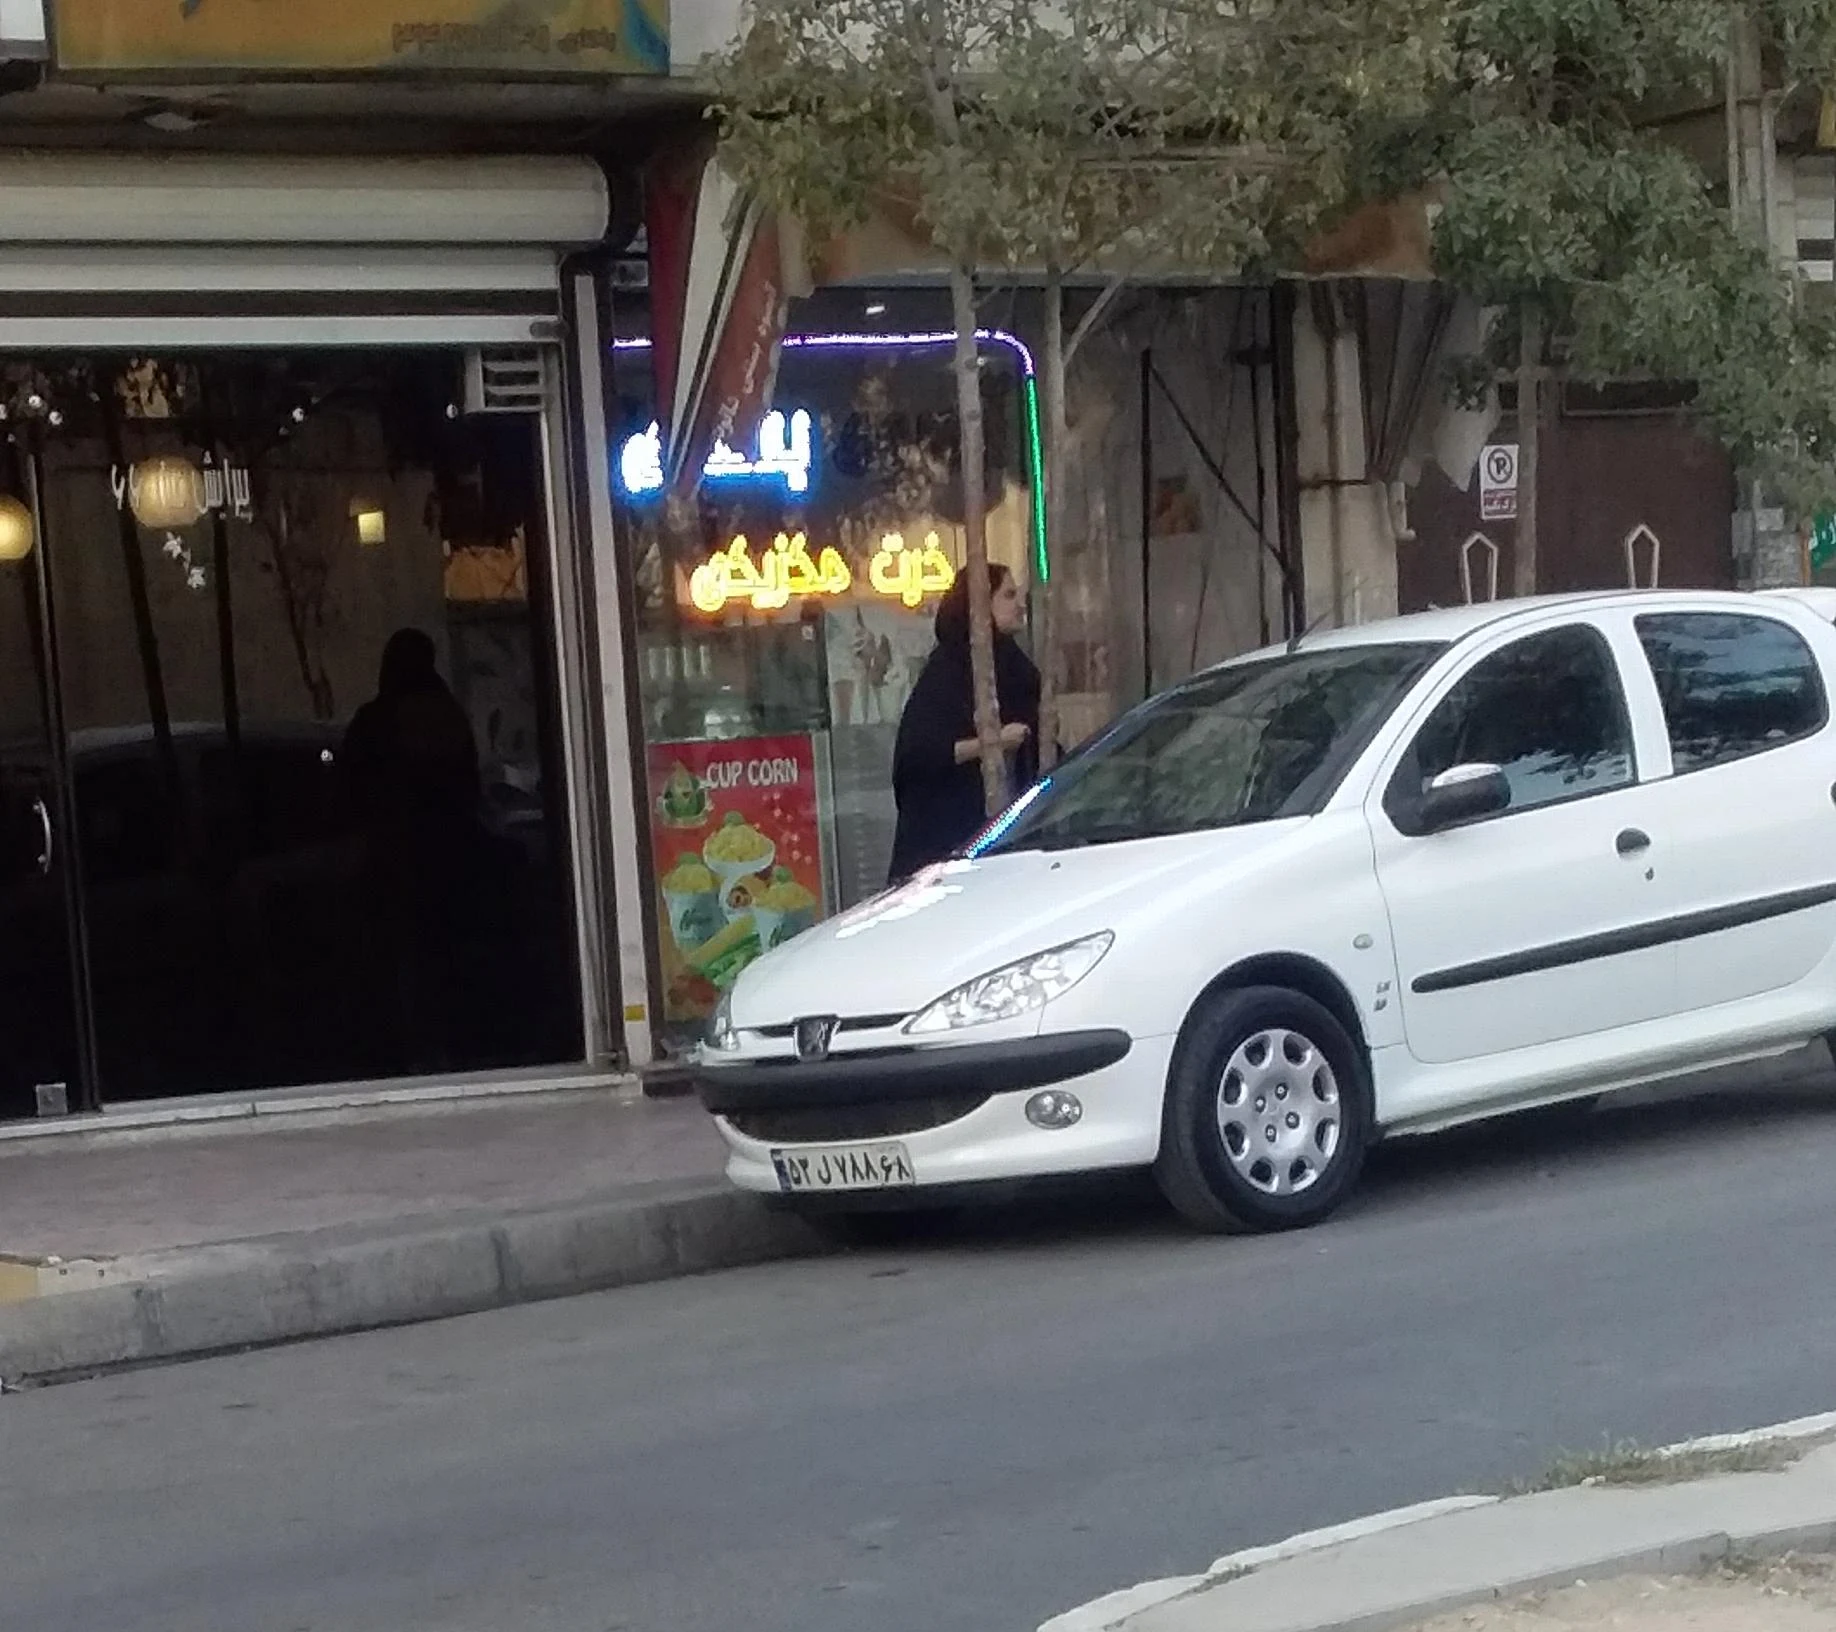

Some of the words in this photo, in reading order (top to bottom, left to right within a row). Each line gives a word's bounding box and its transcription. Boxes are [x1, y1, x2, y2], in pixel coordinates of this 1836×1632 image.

[690, 533, 851, 612] مکزیکی
[869, 532, 956, 608] ذرت
[706, 761, 743, 788] CUP
[747, 757, 799, 786] CORN
